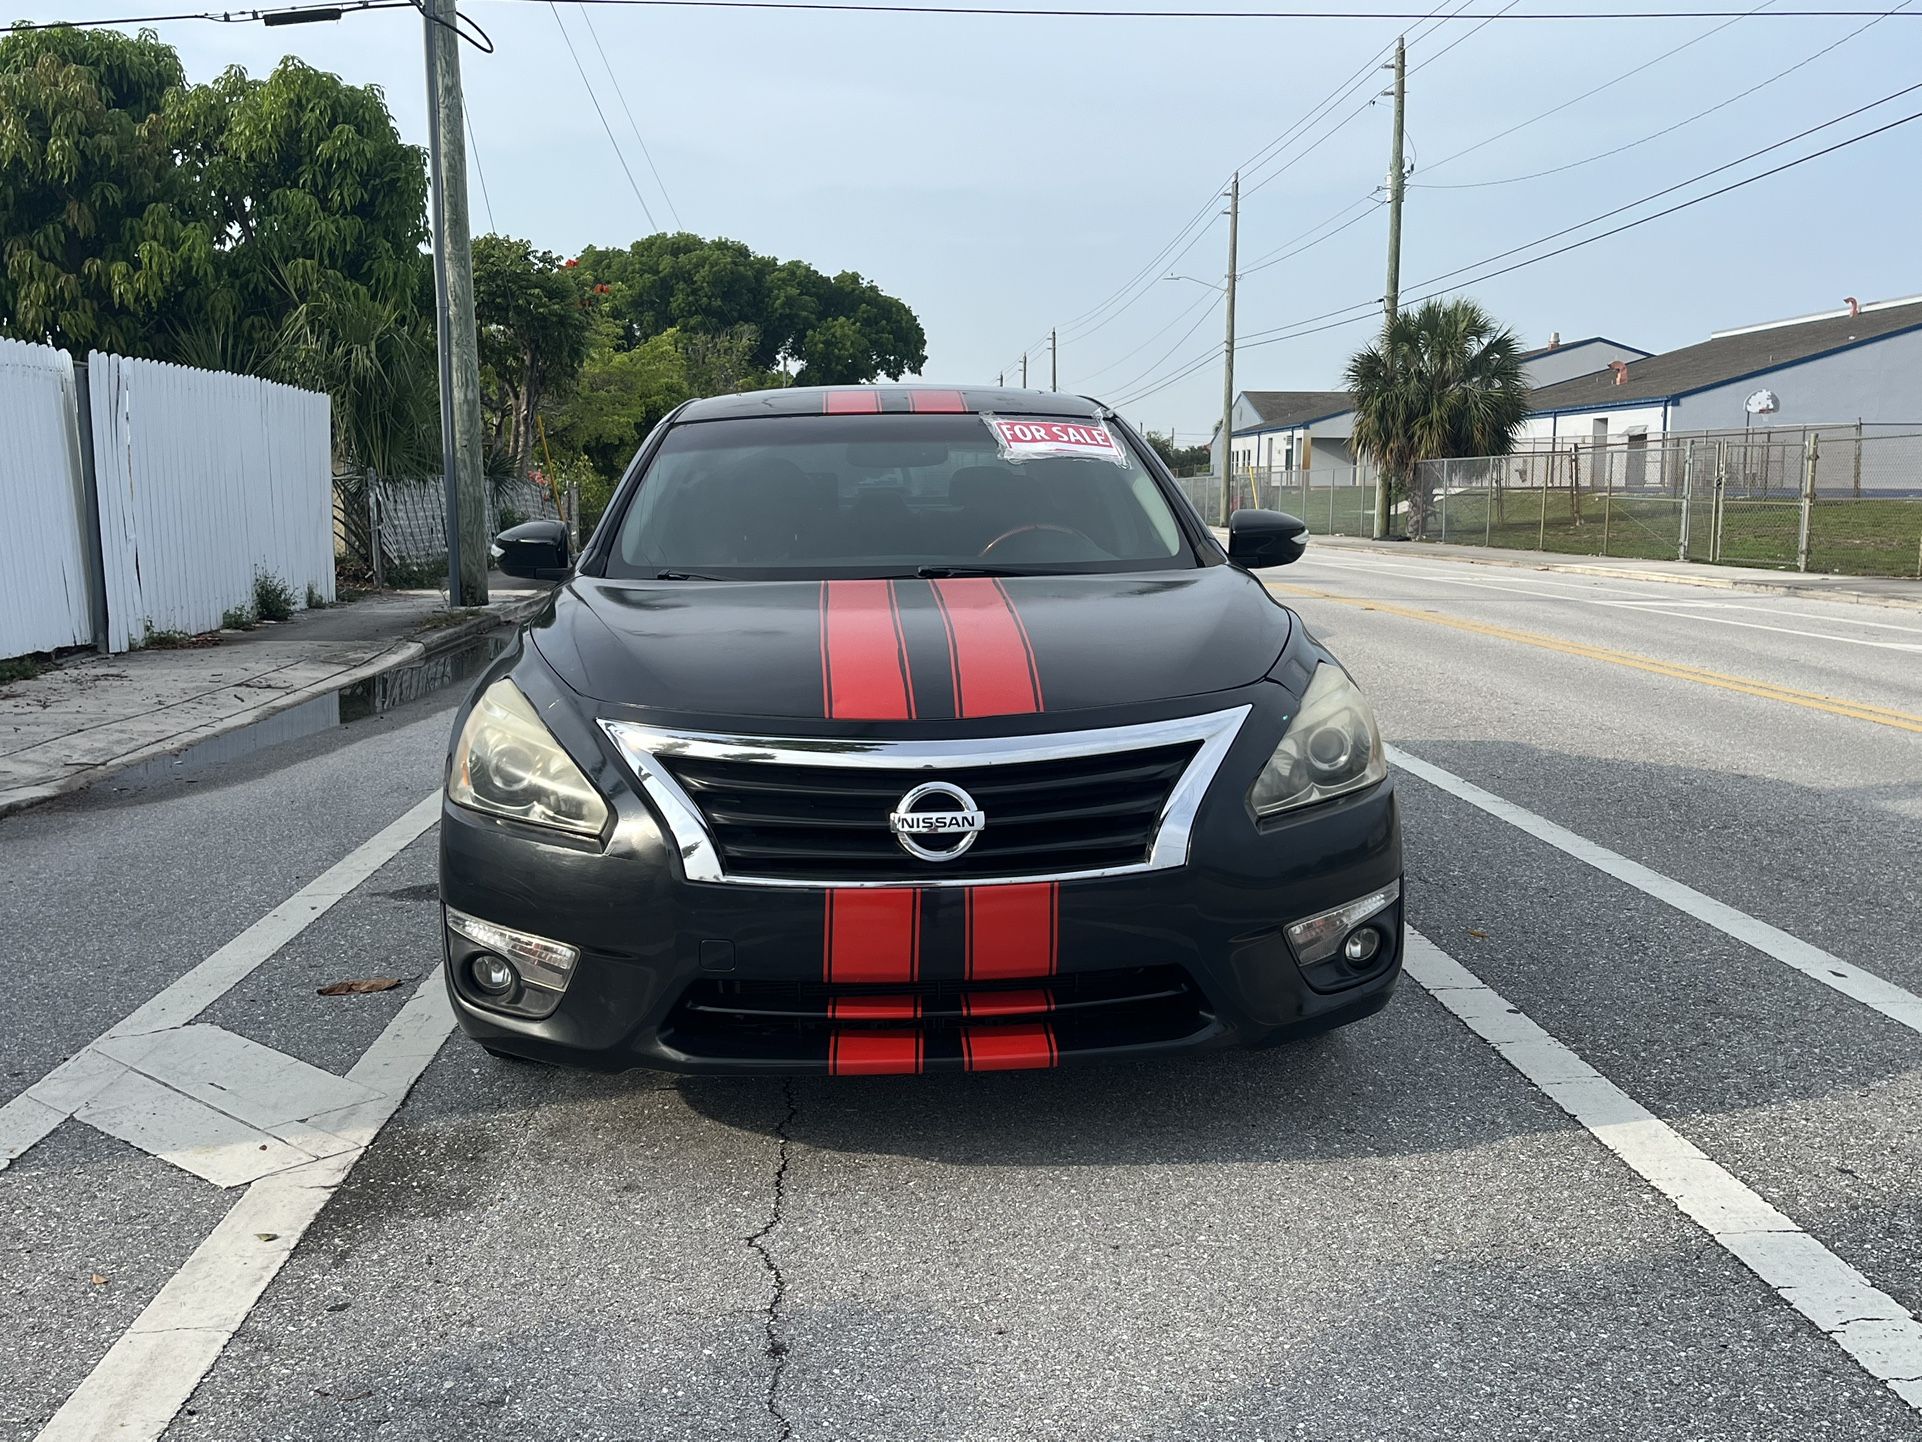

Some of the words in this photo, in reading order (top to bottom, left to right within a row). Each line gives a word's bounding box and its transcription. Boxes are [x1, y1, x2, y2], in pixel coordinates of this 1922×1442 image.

[1001, 424, 1050, 441] FOR
[1051, 426, 1110, 446] SALE
[901, 815, 975, 829] NISSAN
